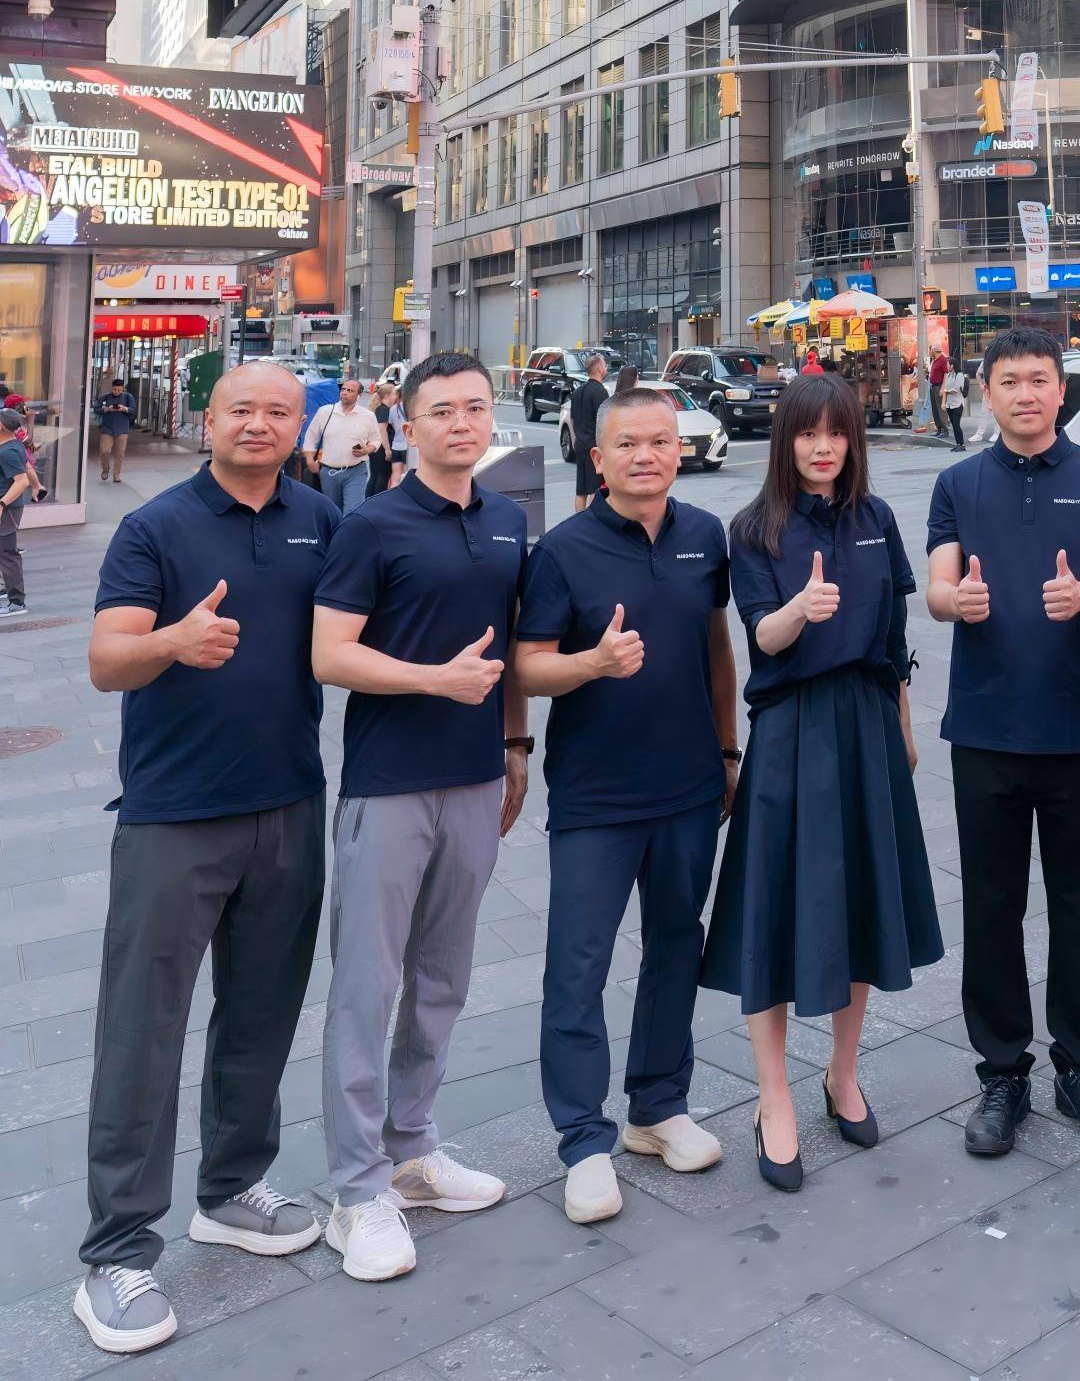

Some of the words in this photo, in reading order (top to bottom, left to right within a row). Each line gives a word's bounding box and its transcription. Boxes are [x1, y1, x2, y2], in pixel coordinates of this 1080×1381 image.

[75, 81, 120, 97] STORE
[155, 86, 193, 100] YORK
[208, 88, 305, 114] EVANGELION
[993, 138, 1034, 152] Nasdaq
[101, 157, 163, 179] BUILD
[856, 151, 901, 166] TOMORROW
[361, 165, 412, 185] Broadway
[942, 163, 996, 180] branded
[172, 179, 225, 209] TEST
[225, 181, 310, 212] TYPE-01
[90, 205, 155, 225] STORE
[156, 207, 231, 227] LIMITED
[156, 275, 226, 291] DINER
